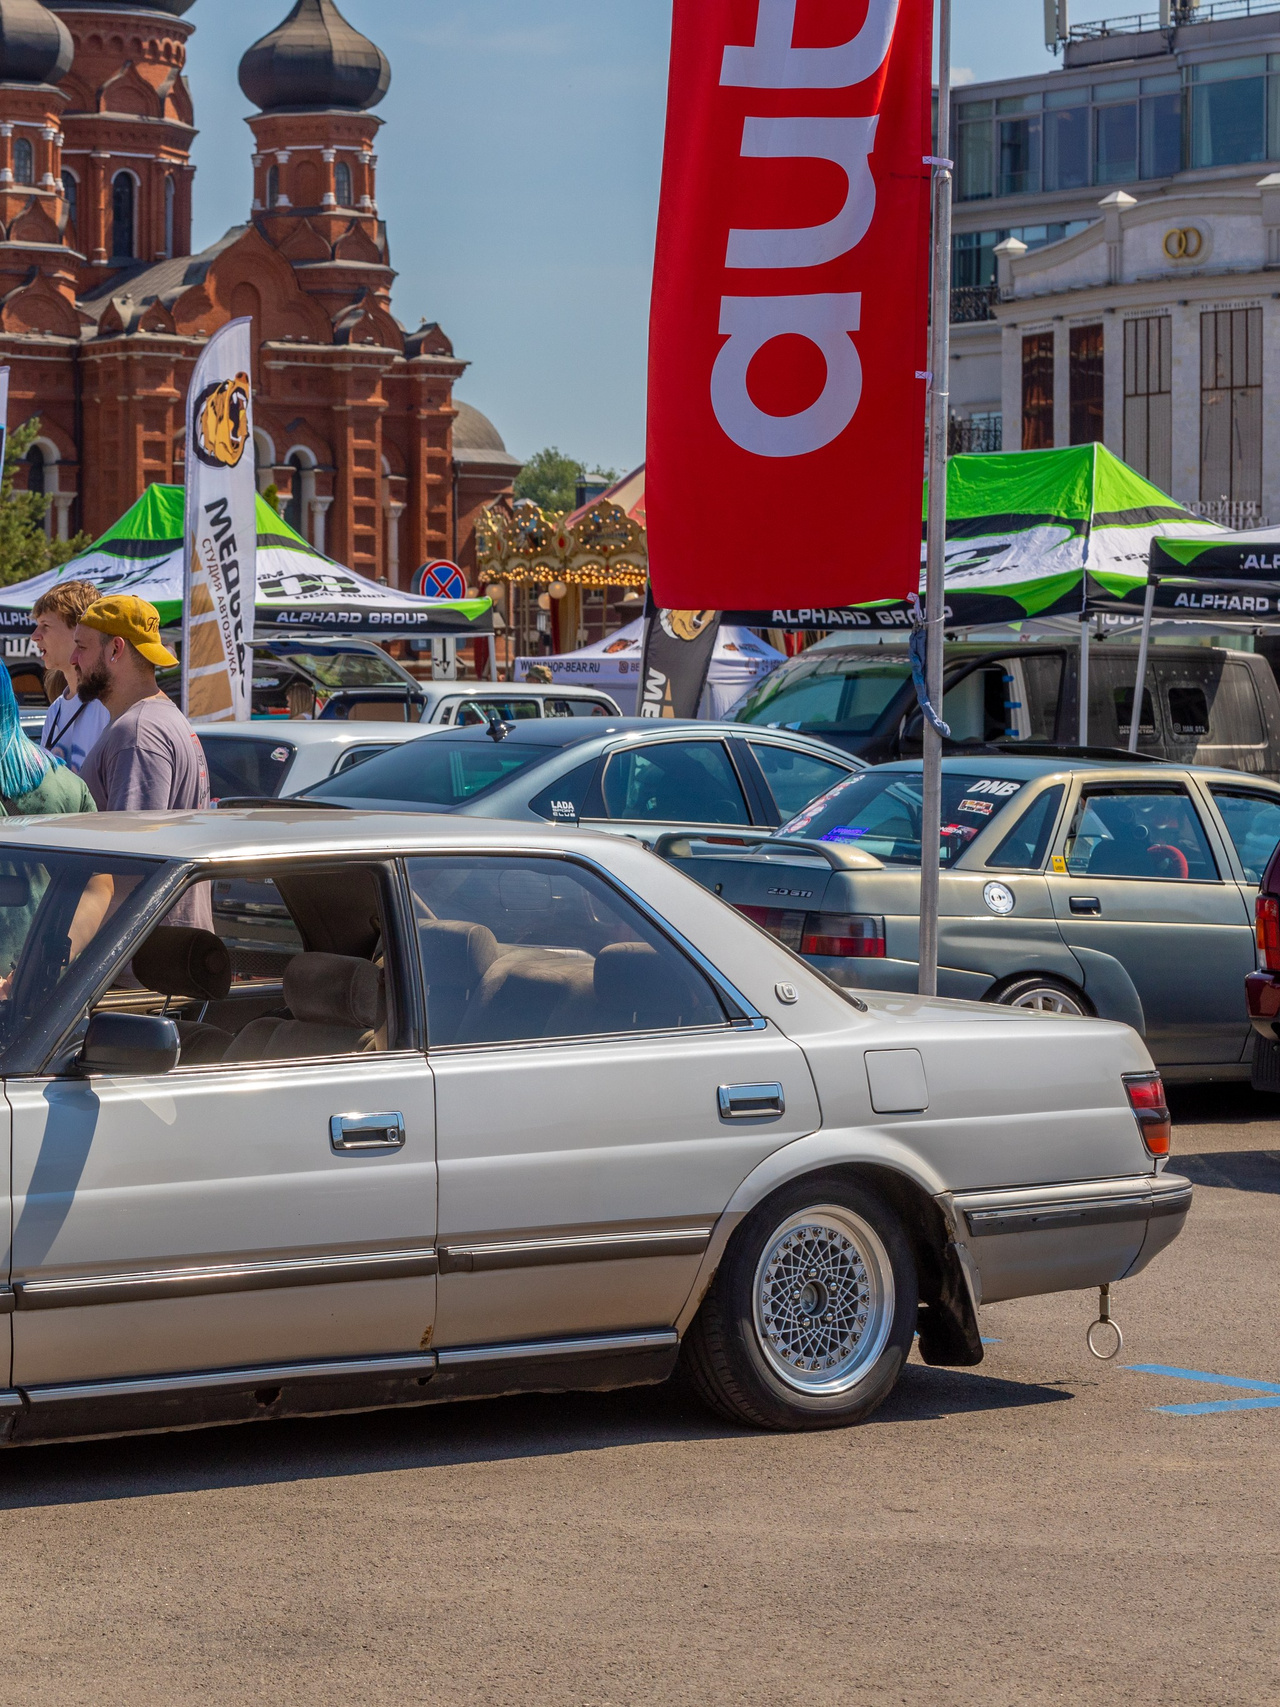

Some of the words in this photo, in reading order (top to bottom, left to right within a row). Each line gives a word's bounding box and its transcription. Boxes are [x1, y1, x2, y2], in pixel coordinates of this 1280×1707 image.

[202, 537, 223, 592] СТУДИЯ
[217, 595, 237, 677] АВТОЗВУКА
[1174, 592, 1270, 611] ALPHARD
[276, 611, 362, 624] ALPHARD
[368, 612, 428, 625] GROUP
[772, 608, 871, 625] ALPHARD
[967, 780, 1021, 796] DNB
[551, 800, 575, 810] LADA
[767, 887, 790, 895] 2.0
[790, 889, 813, 898] GTI
